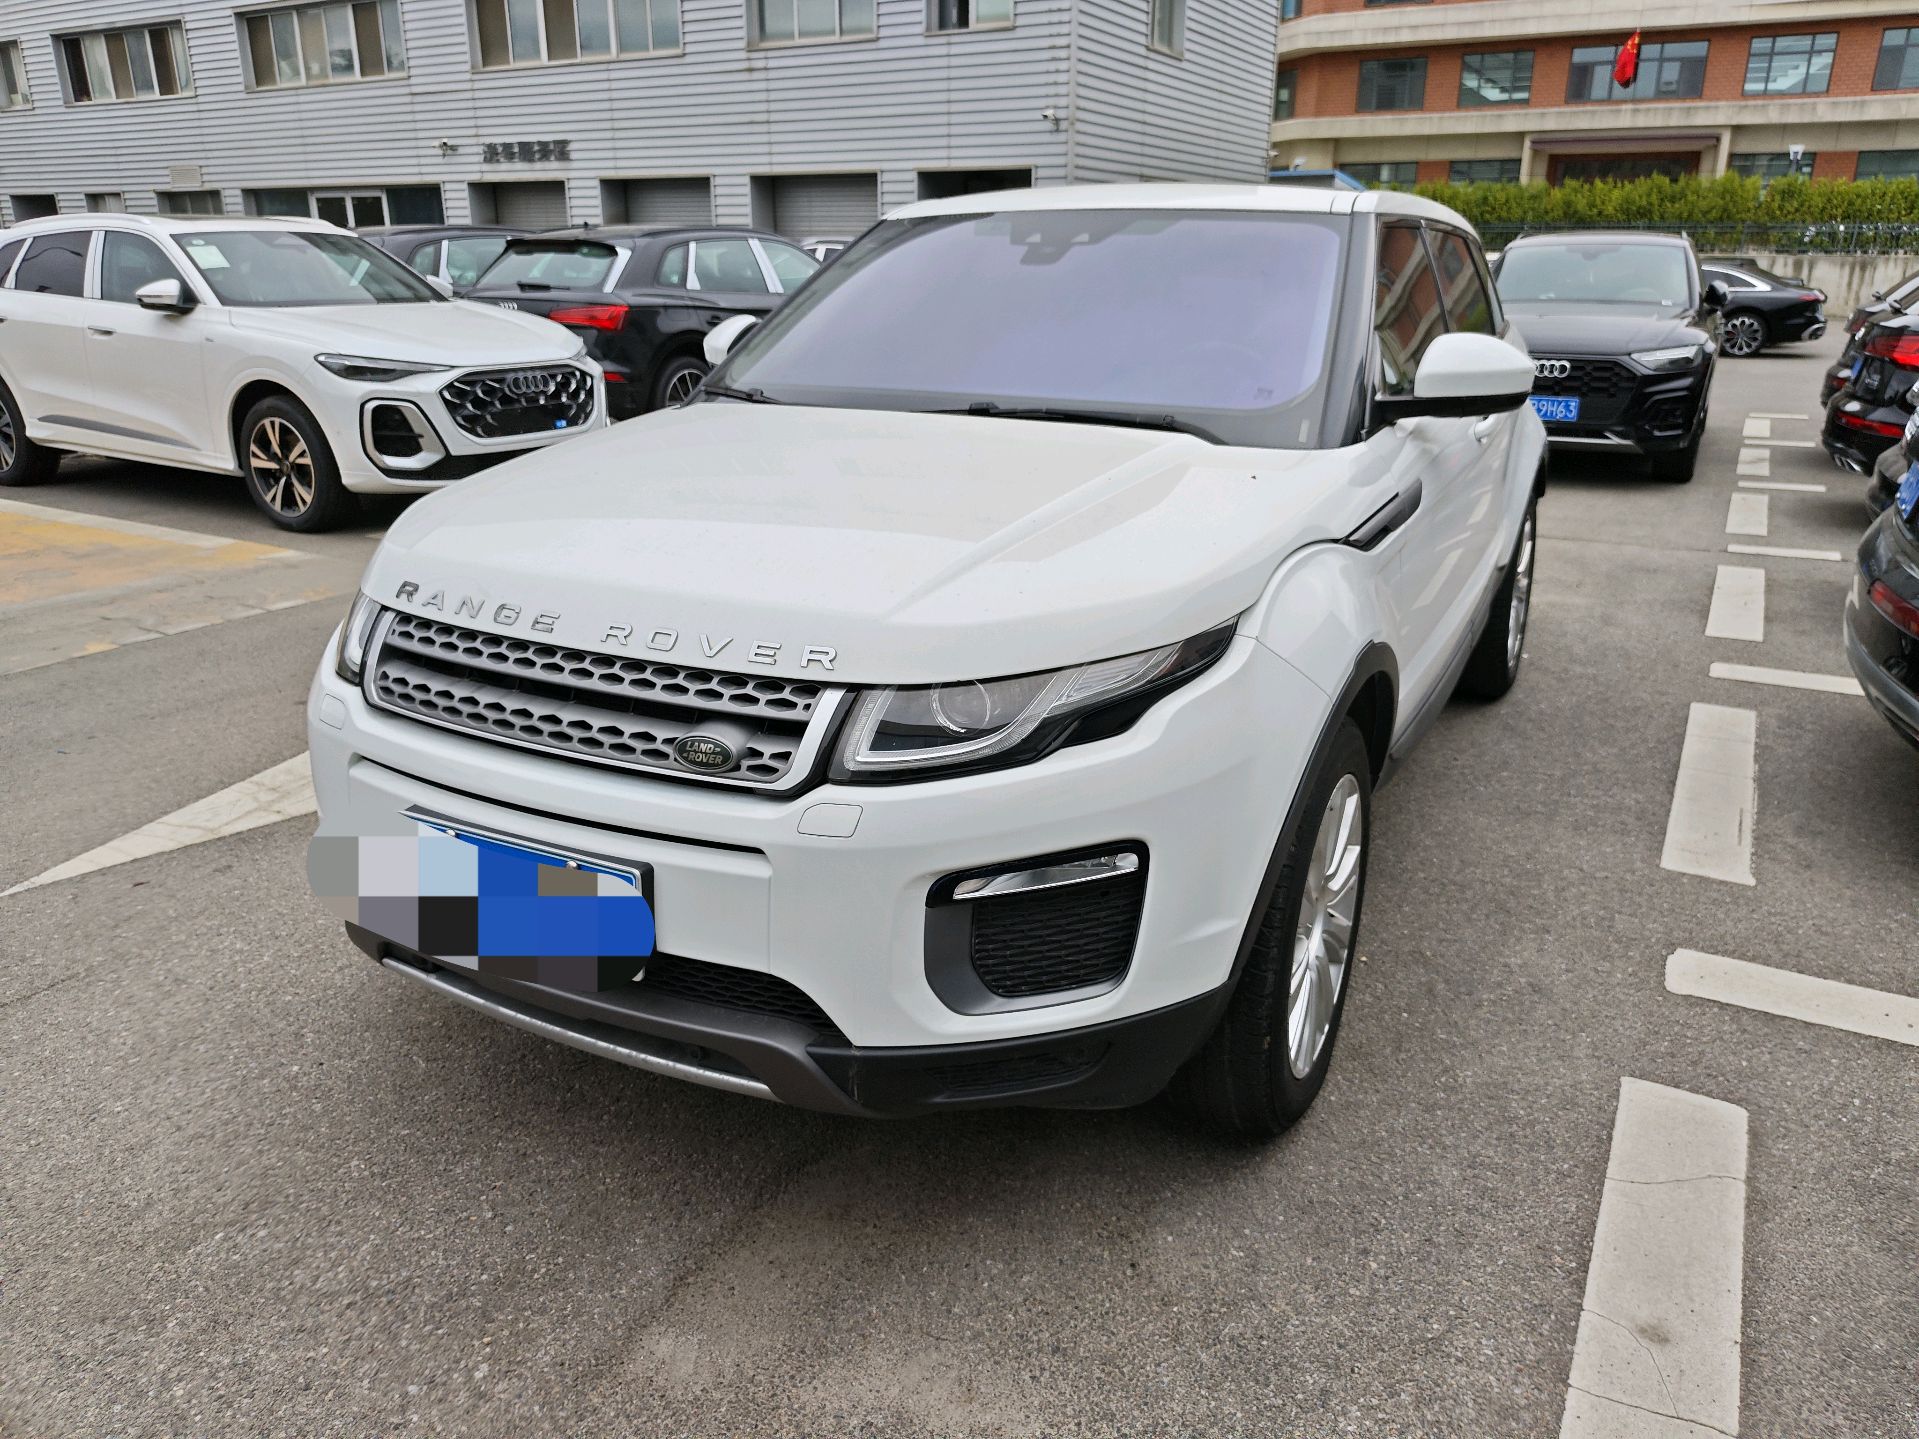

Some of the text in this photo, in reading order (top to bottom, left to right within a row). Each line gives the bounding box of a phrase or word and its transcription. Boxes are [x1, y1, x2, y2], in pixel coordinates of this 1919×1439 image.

[395, 580, 837, 670] RANGE ROVER
[686, 741, 715, 753] LAND
[688, 751, 723, 765] ROVER
